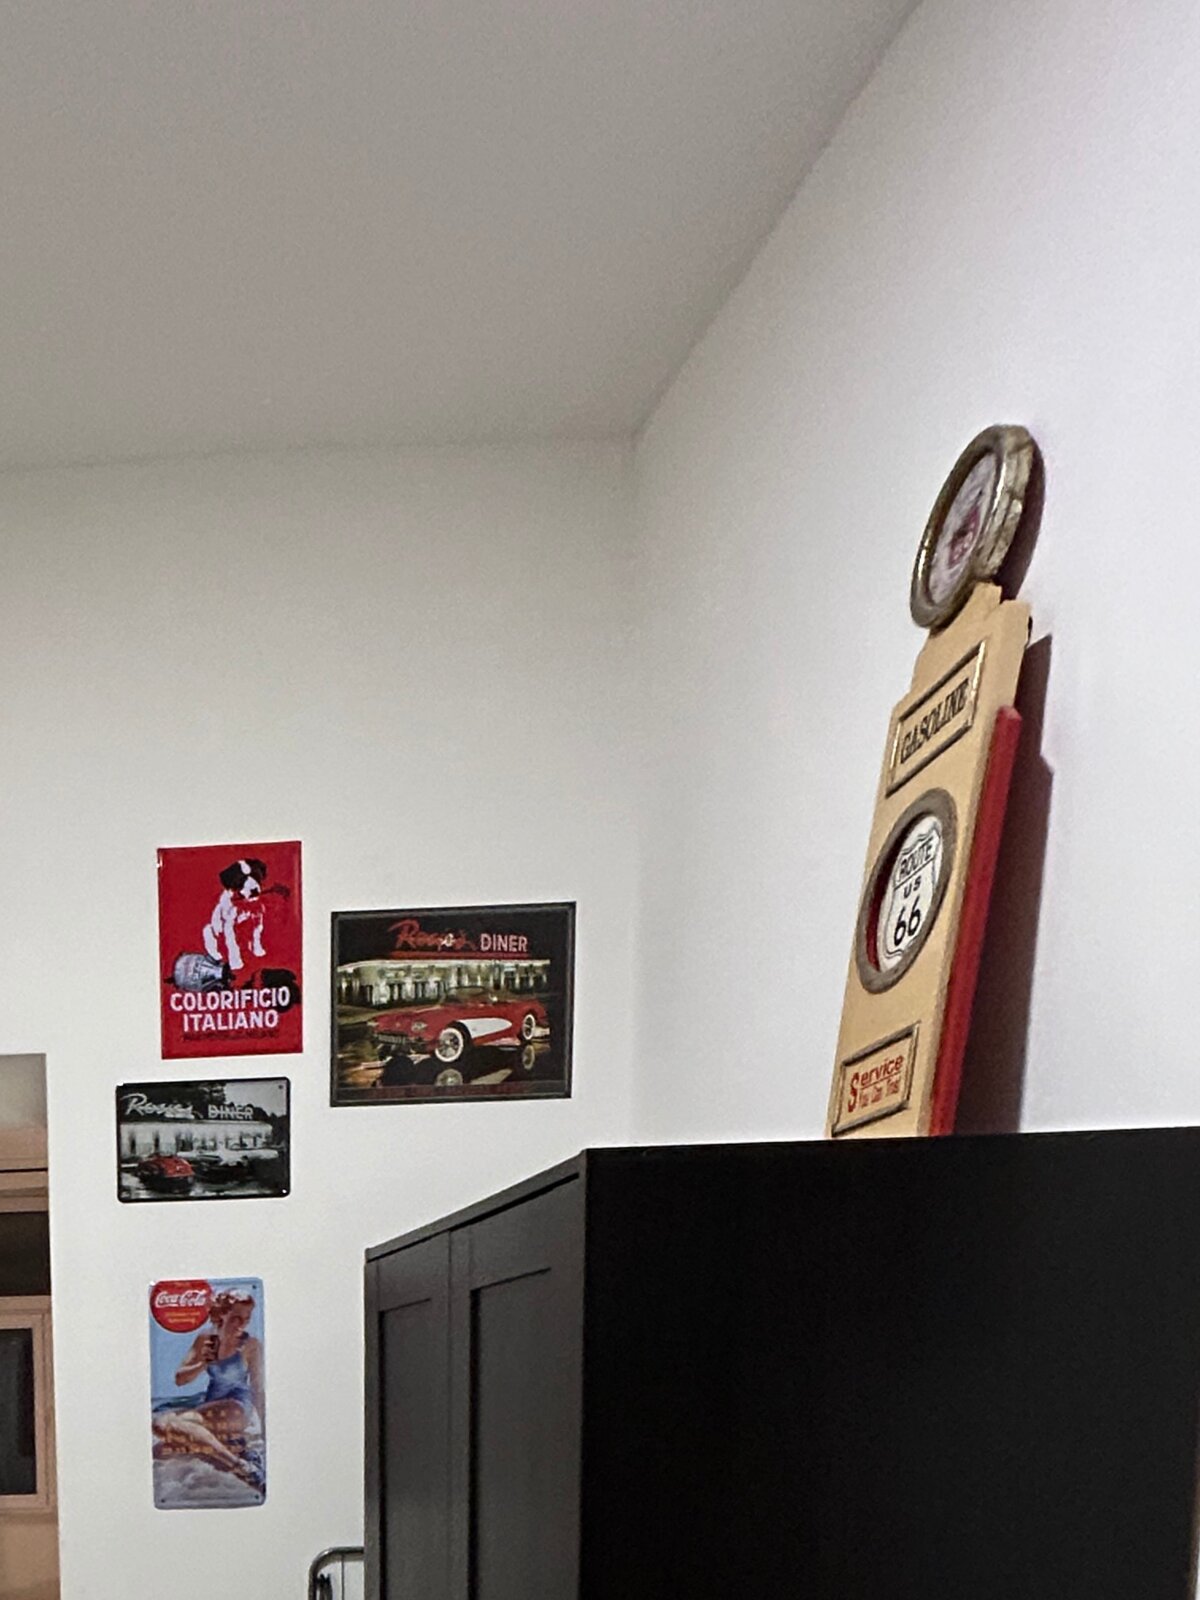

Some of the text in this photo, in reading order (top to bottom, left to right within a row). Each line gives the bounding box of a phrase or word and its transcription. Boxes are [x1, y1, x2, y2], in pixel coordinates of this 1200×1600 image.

[900, 677, 969, 764] GASOLINE
[899, 842, 933, 880] ROUTE
[904, 876, 921, 898] US
[894, 895, 921, 946] 66
[480, 932, 528, 952] DINER
[169, 986, 290, 1011] COLORIFICIO
[183, 1009, 279, 1032] ITALIANO
[848, 1055, 904, 1112] Service
[208, 1104, 254, 1119] DINER
